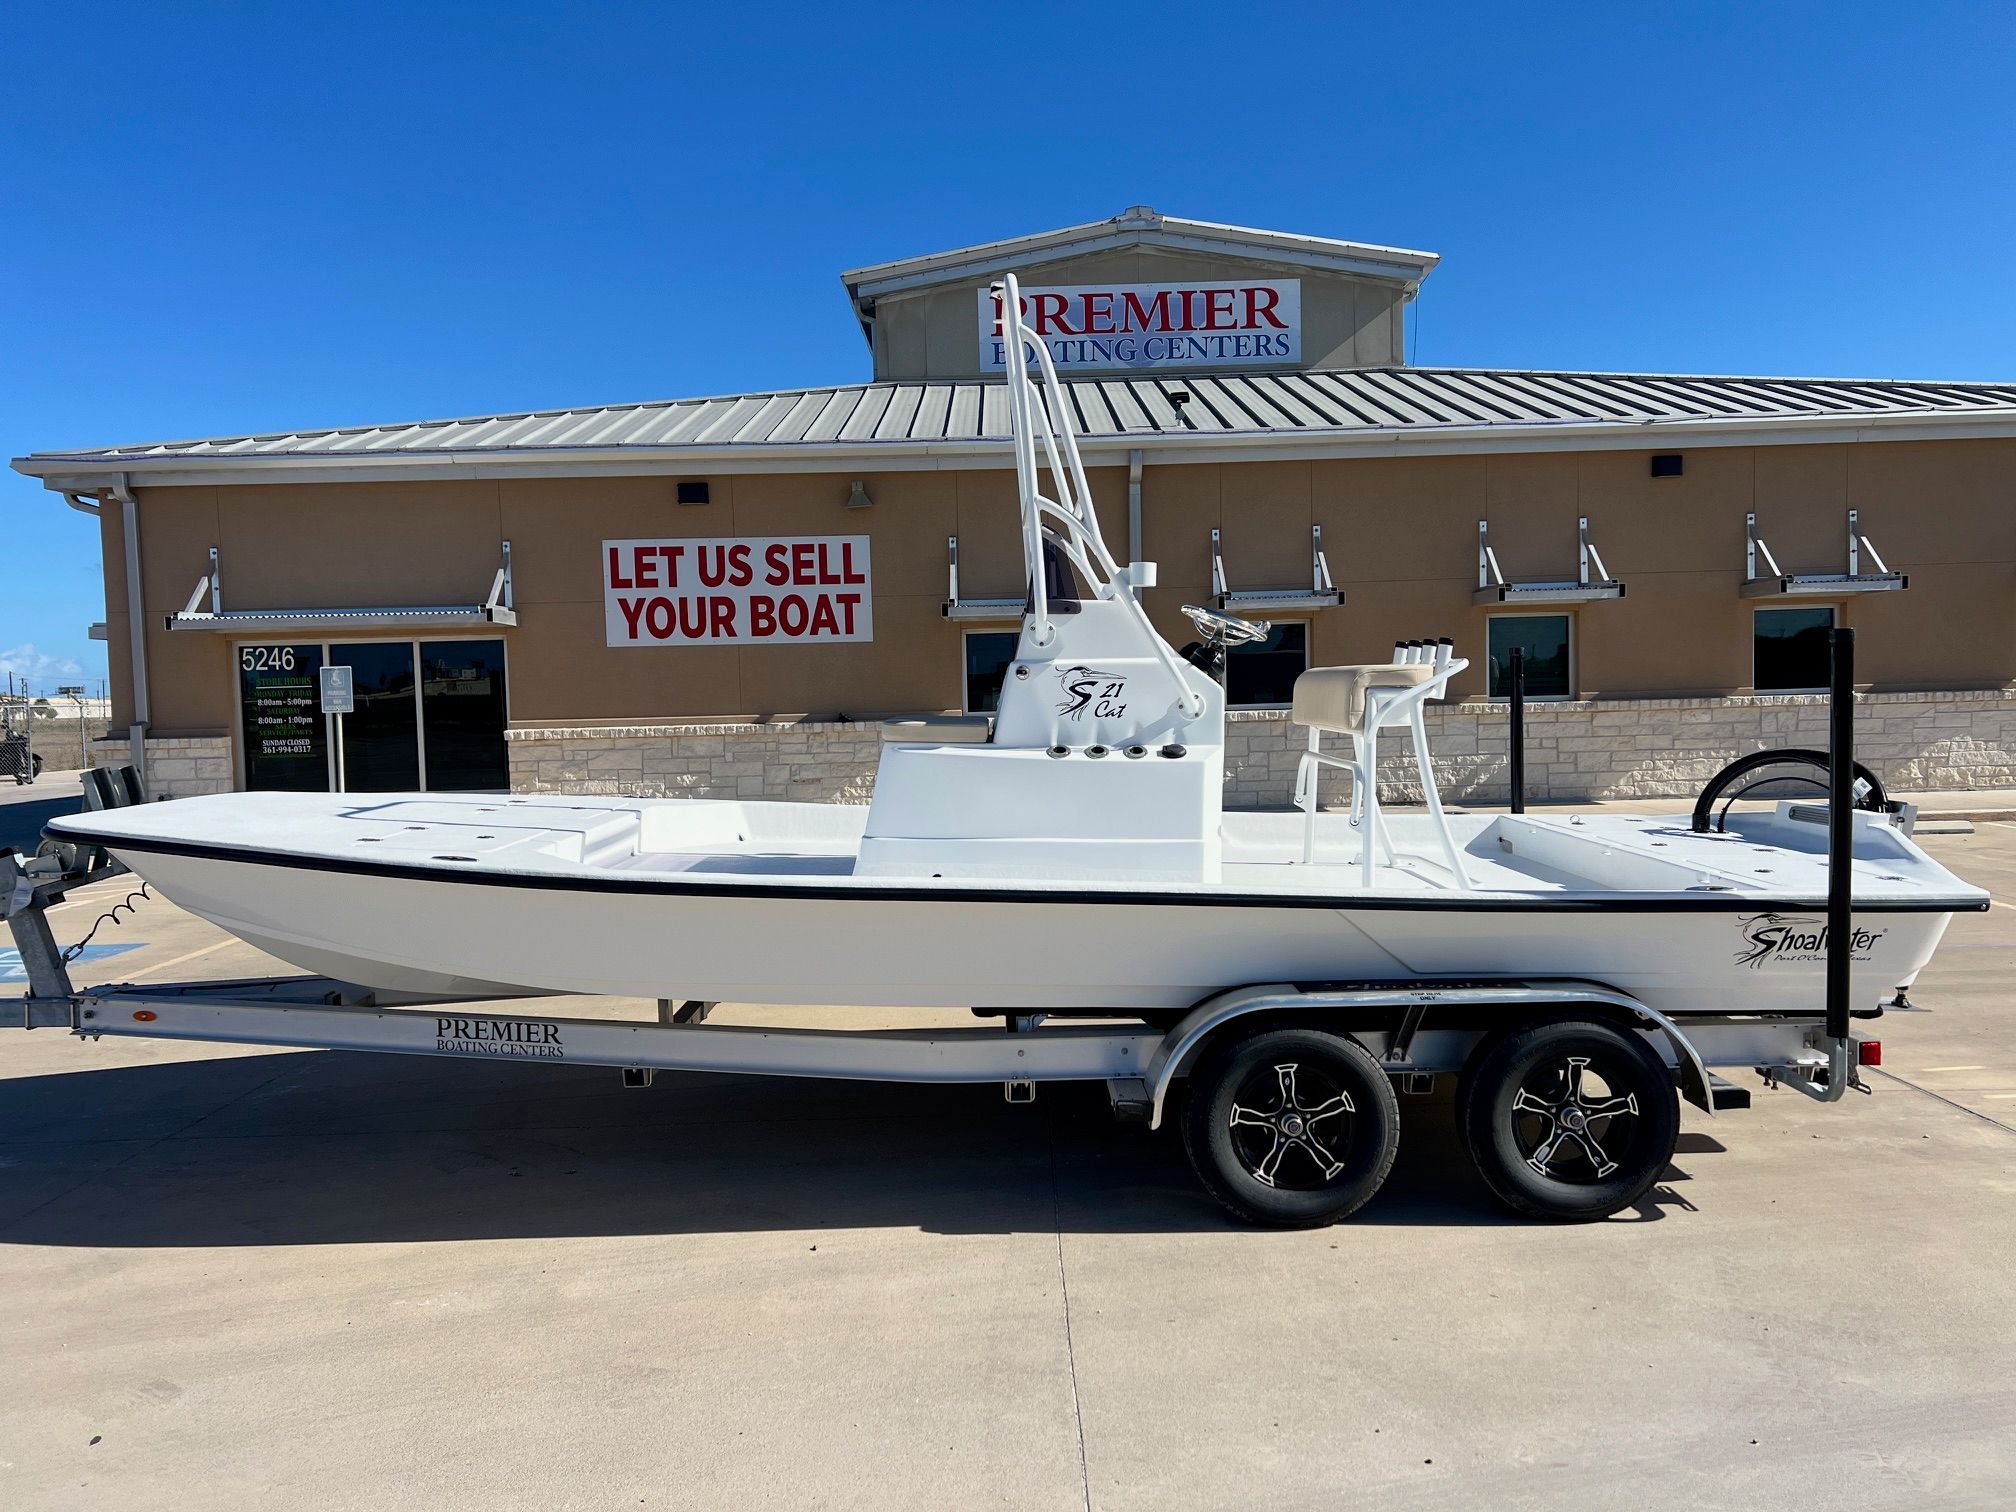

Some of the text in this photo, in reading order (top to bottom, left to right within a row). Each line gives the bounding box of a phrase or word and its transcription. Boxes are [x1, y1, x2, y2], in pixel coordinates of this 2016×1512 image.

[990, 287, 1289, 337] PREMIER
[1144, 333, 1290, 361] CENTERS
[609, 542, 865, 589] LET US SELL
[617, 593, 861, 640] YOUR BOAT
[242, 647, 295, 671] 5246
[256, 677, 312, 686] STORE HOURS
[1099, 683, 1125, 698] 21
[256, 690, 284, 698] MONDAY
[288, 689, 312, 697] FRIDAY
[287, 698, 312, 707] 5:00pm
[267, 707, 301, 715] SATURDAY
[1094, 700, 1127, 719] Cat
[258, 717, 283, 725] 8:00am
[288, 716, 313, 725] 1:00pm
[262, 746, 311, 754] 361-994-0317
[1735, 926, 1883, 966] Shoalter
[436, 1018, 563, 1045] PREMIER
[436, 1039, 564, 1058] BOATING CENTERS
